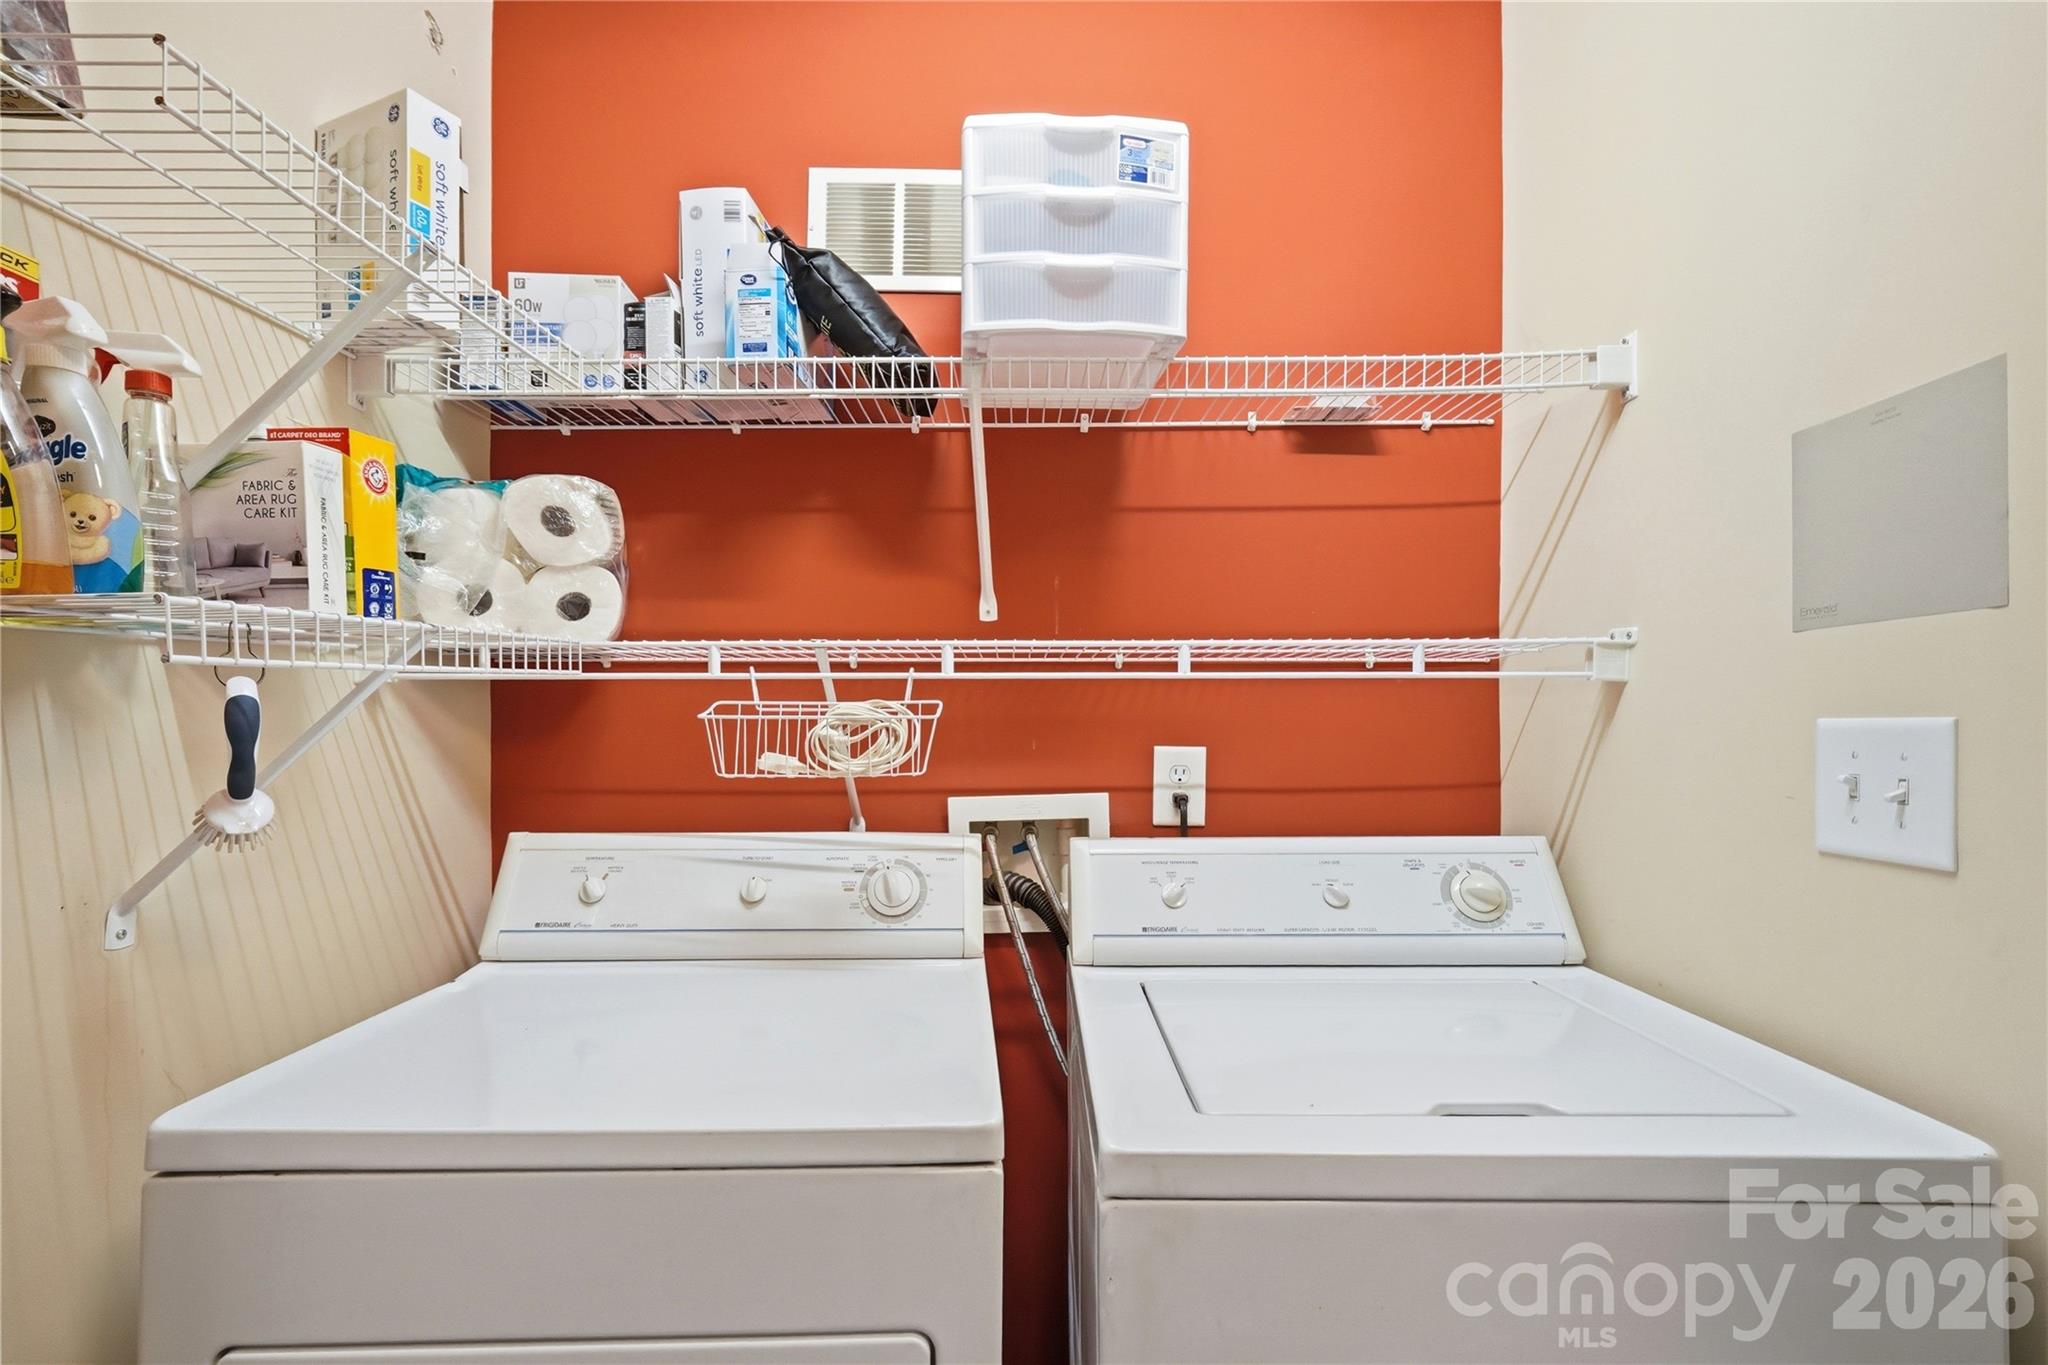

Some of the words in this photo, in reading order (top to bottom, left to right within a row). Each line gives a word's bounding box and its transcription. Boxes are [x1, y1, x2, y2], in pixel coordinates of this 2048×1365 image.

[389, 149, 399, 184] soft
[435, 160, 449, 196] soft
[389, 186, 399, 231] whie
[435, 198, 449, 246] white
[693, 268, 703, 306] white
[693, 306, 704, 337] soft
[277, 431, 304, 439] CARPET
[318, 431, 341, 439] BRAND
[236, 494, 265, 505] AREA
[271, 493, 297, 505] RUG
[242, 481, 284, 491] FABRIC
[289, 480, 296, 491] &
[244, 508, 275, 519] CARE
[280, 507, 298, 518] KIT
